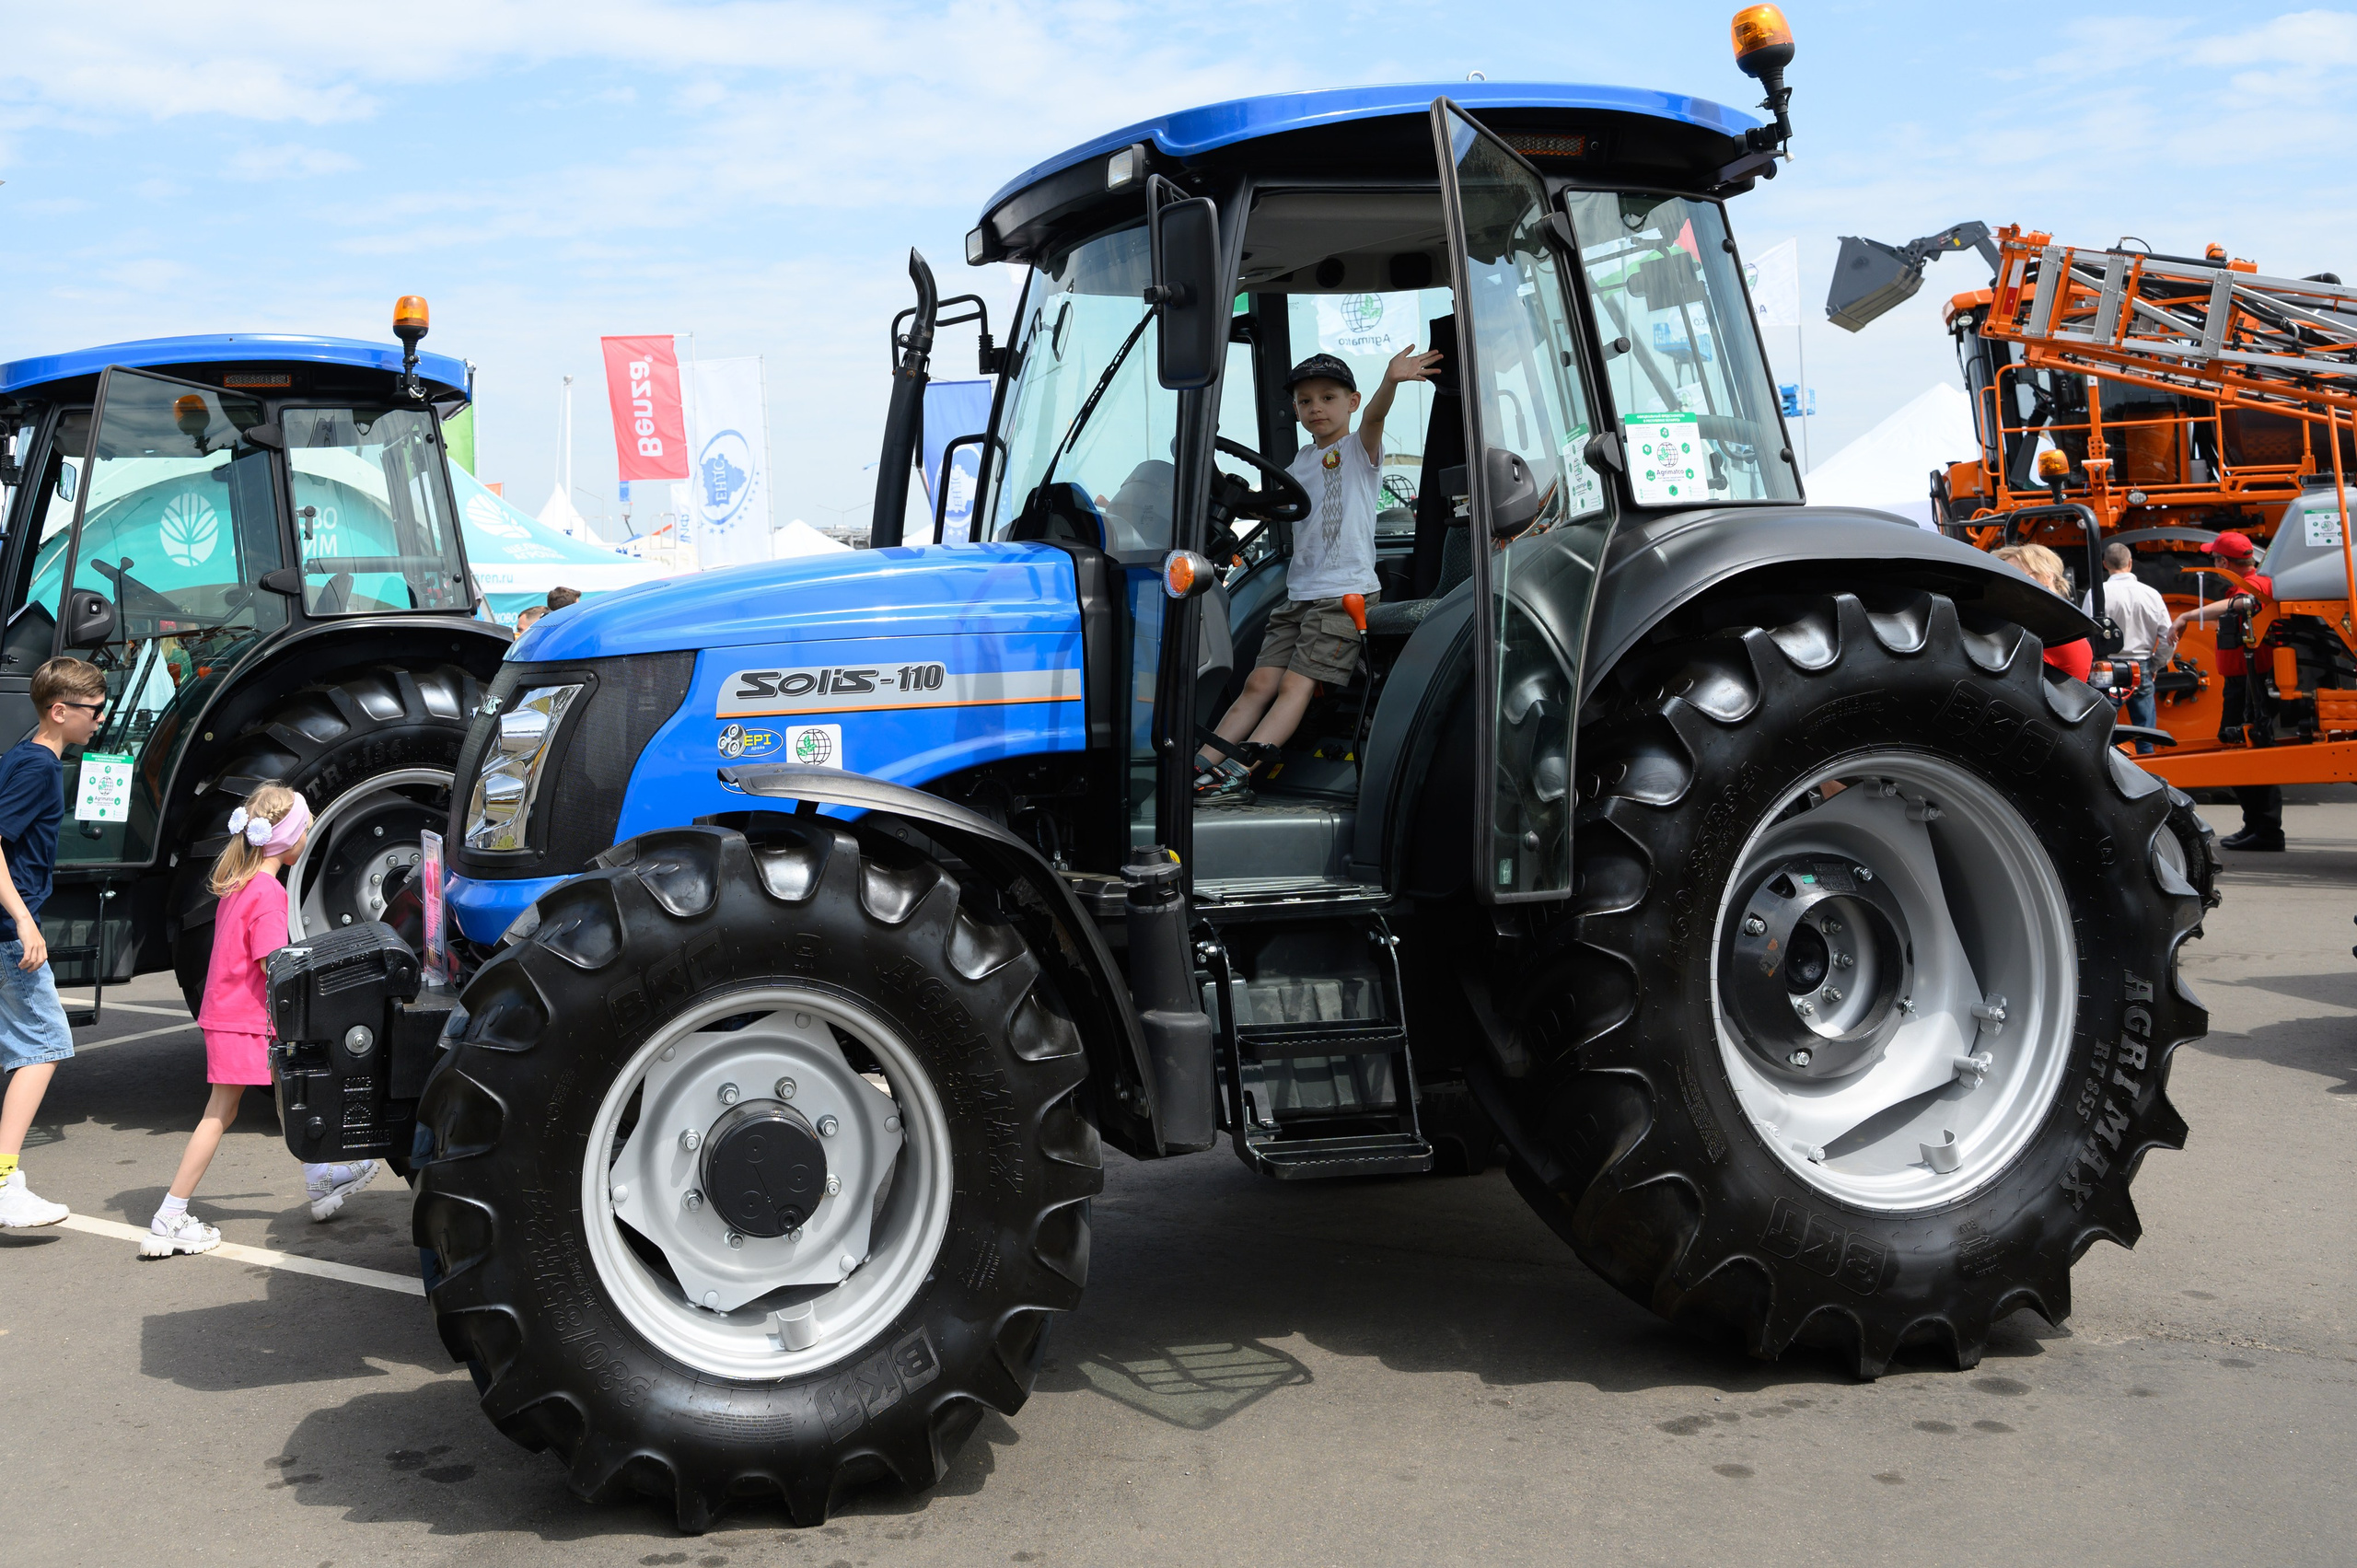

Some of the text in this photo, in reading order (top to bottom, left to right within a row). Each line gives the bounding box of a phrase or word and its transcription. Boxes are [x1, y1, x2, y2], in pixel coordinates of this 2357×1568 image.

[744, 733, 772, 747] EPI
[2059, 968, 2154, 1213] AGRI MAX
[2074, 1040, 2113, 1121] RT 855
[820, 1328, 941, 1433] BKT
